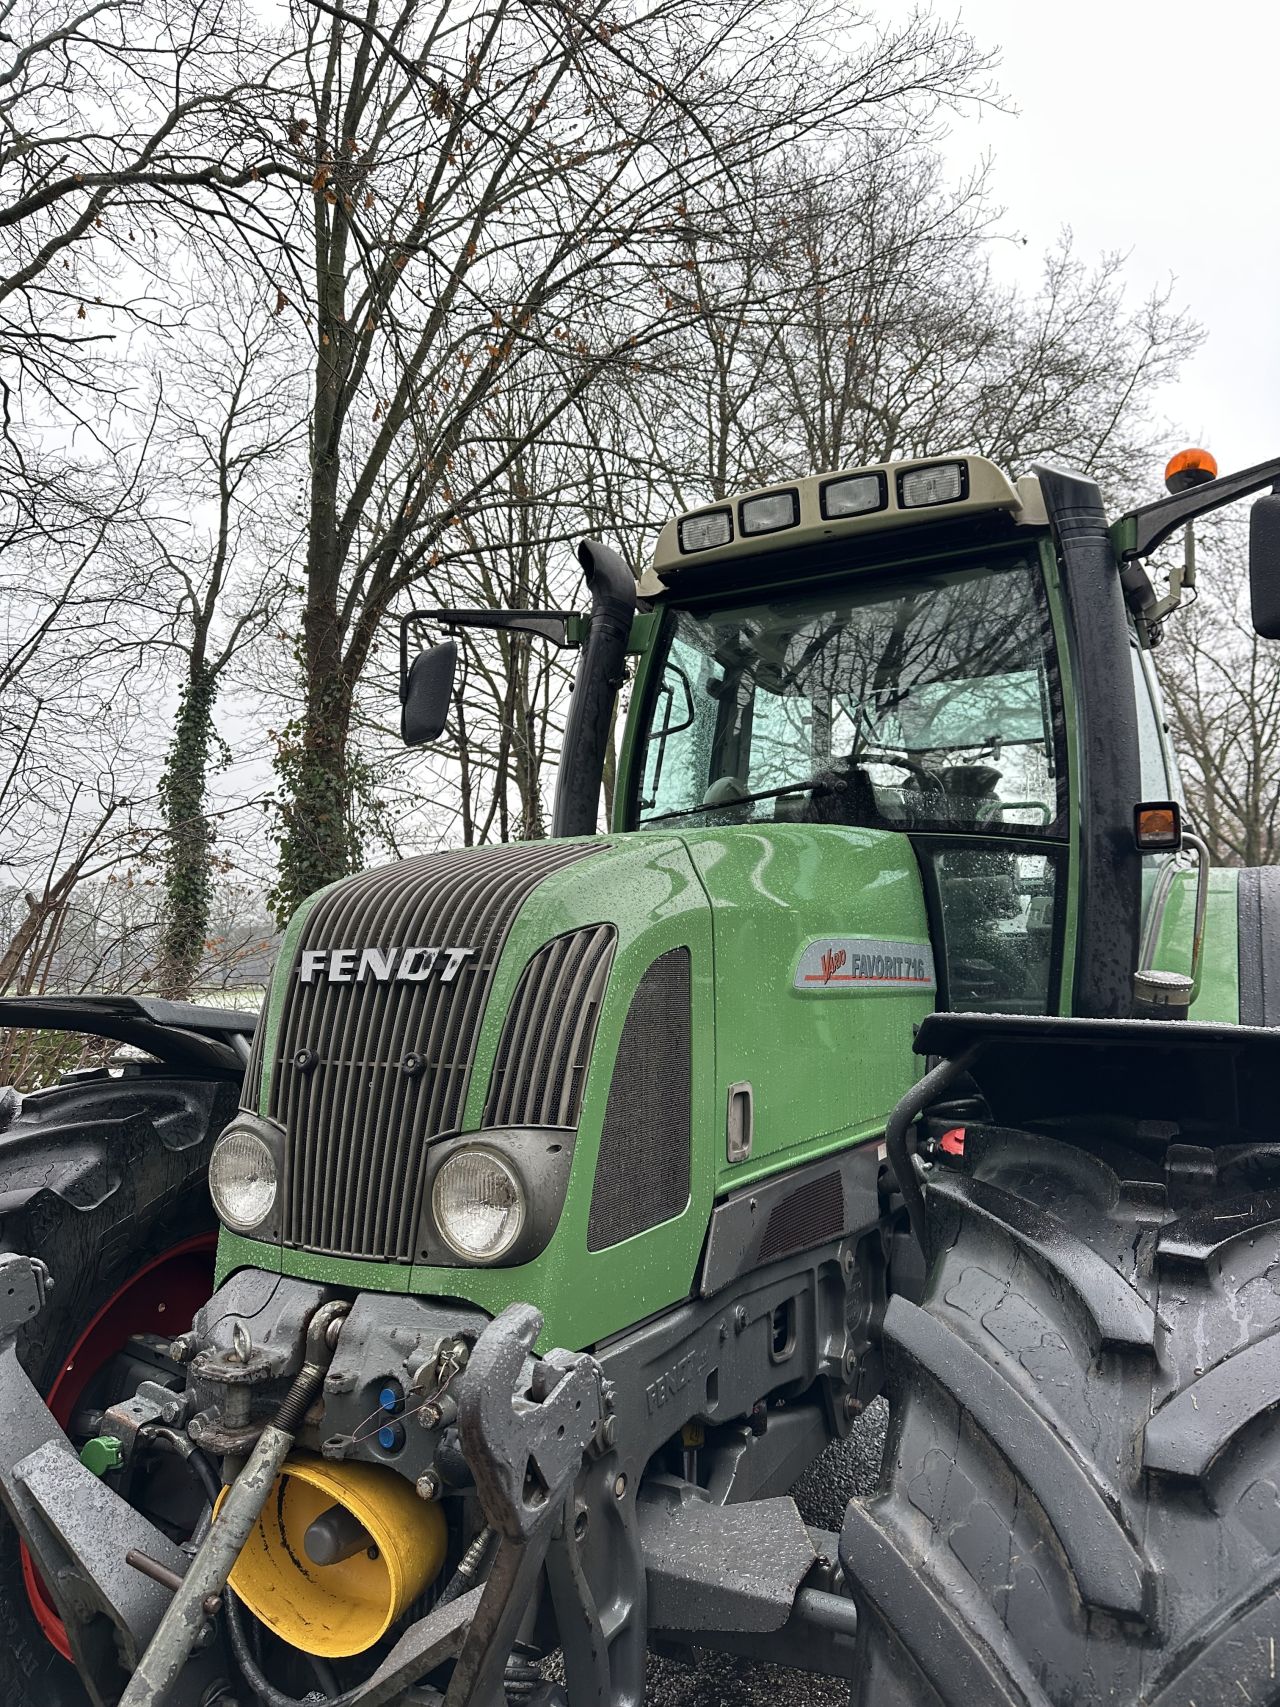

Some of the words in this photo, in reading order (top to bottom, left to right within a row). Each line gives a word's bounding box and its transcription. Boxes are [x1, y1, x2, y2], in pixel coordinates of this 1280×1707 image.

[300, 947, 475, 982] FENDT
[851, 953, 903, 979] FAVORIT
[904, 957, 925, 981] 716
